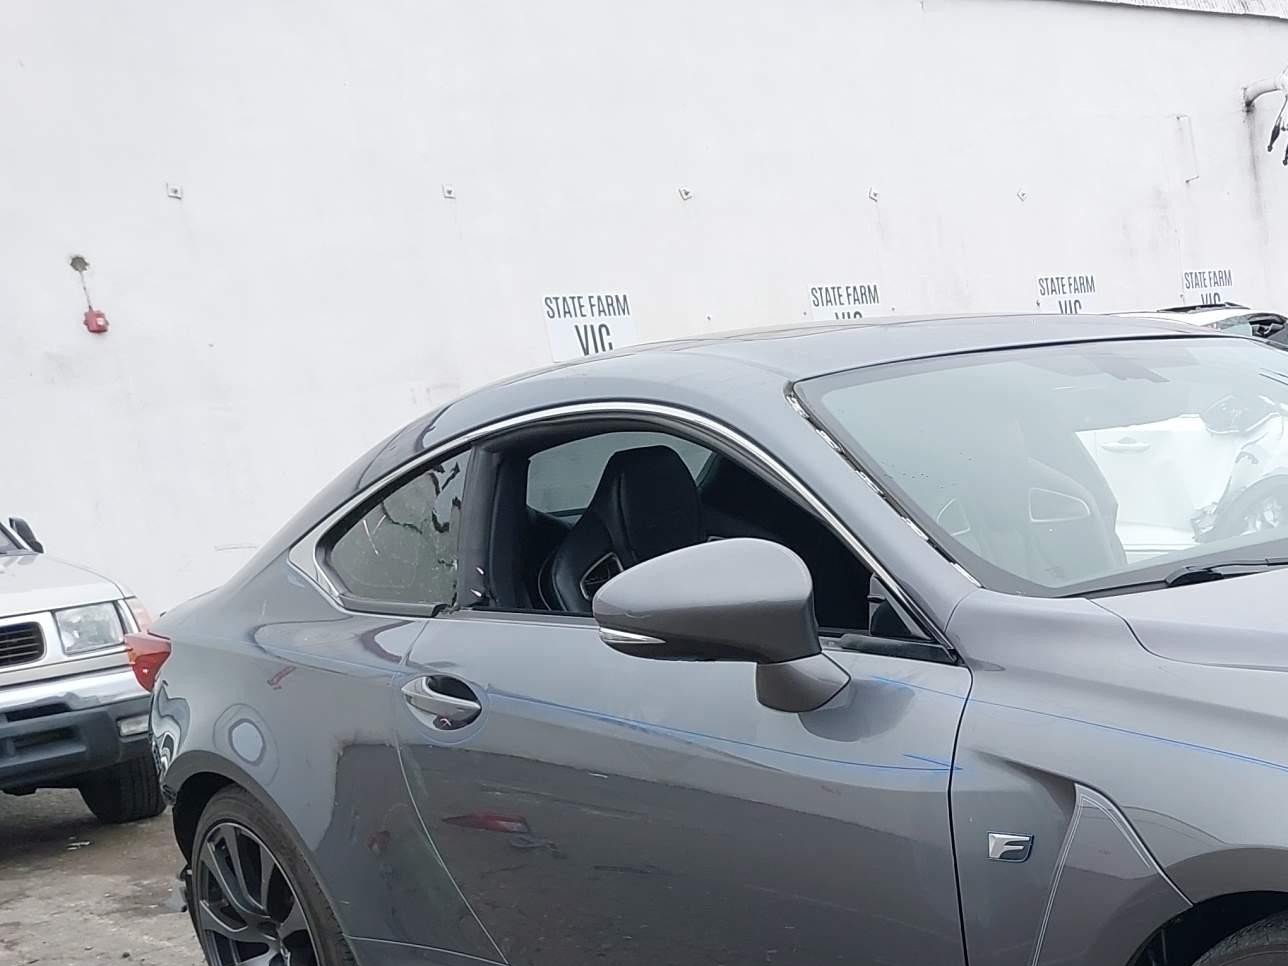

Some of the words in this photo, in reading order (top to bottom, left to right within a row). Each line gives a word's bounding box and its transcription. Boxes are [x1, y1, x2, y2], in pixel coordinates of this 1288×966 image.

[1038, 277, 1067, 296] STATE
[1067, 275, 1096, 294] FARM
[1184, 271, 1208, 289] STATE
[1208, 269, 1233, 288] FARM
[544, 296, 587, 319] STATE
[588, 294, 631, 318] FARM
[811, 286, 845, 307] STATE
[845, 284, 880, 305] FARM
[574, 323, 613, 356] VIC
